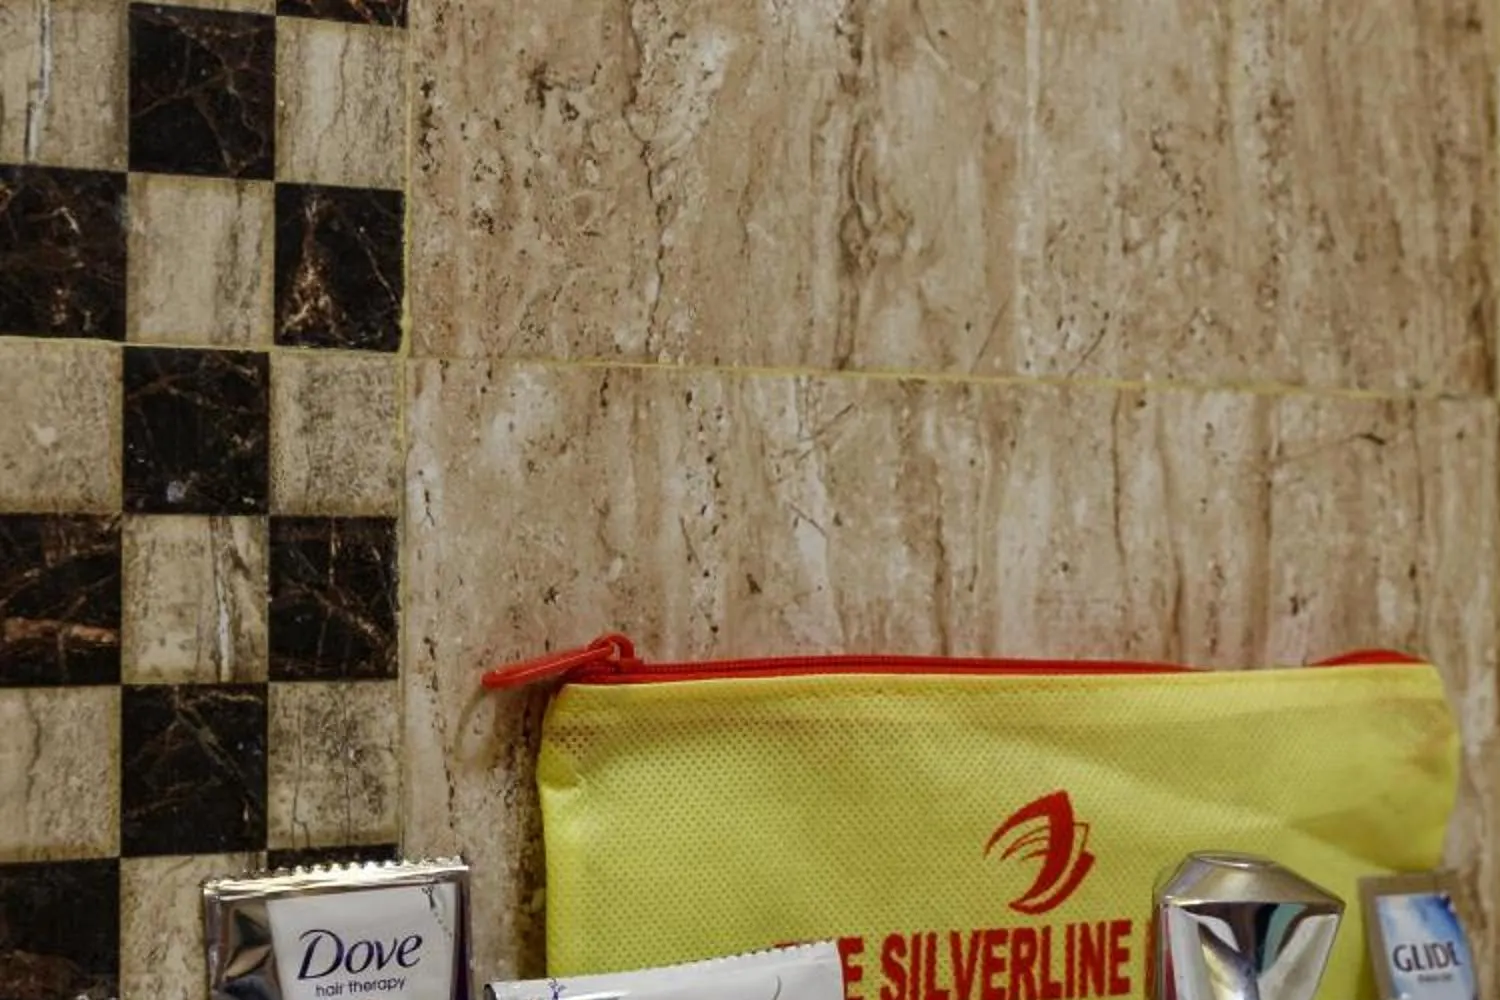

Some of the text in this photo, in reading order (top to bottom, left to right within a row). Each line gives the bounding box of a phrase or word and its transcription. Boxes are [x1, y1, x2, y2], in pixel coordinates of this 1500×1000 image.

[297, 929, 423, 980] Dove
[316, 976, 405, 998] hair therapy
